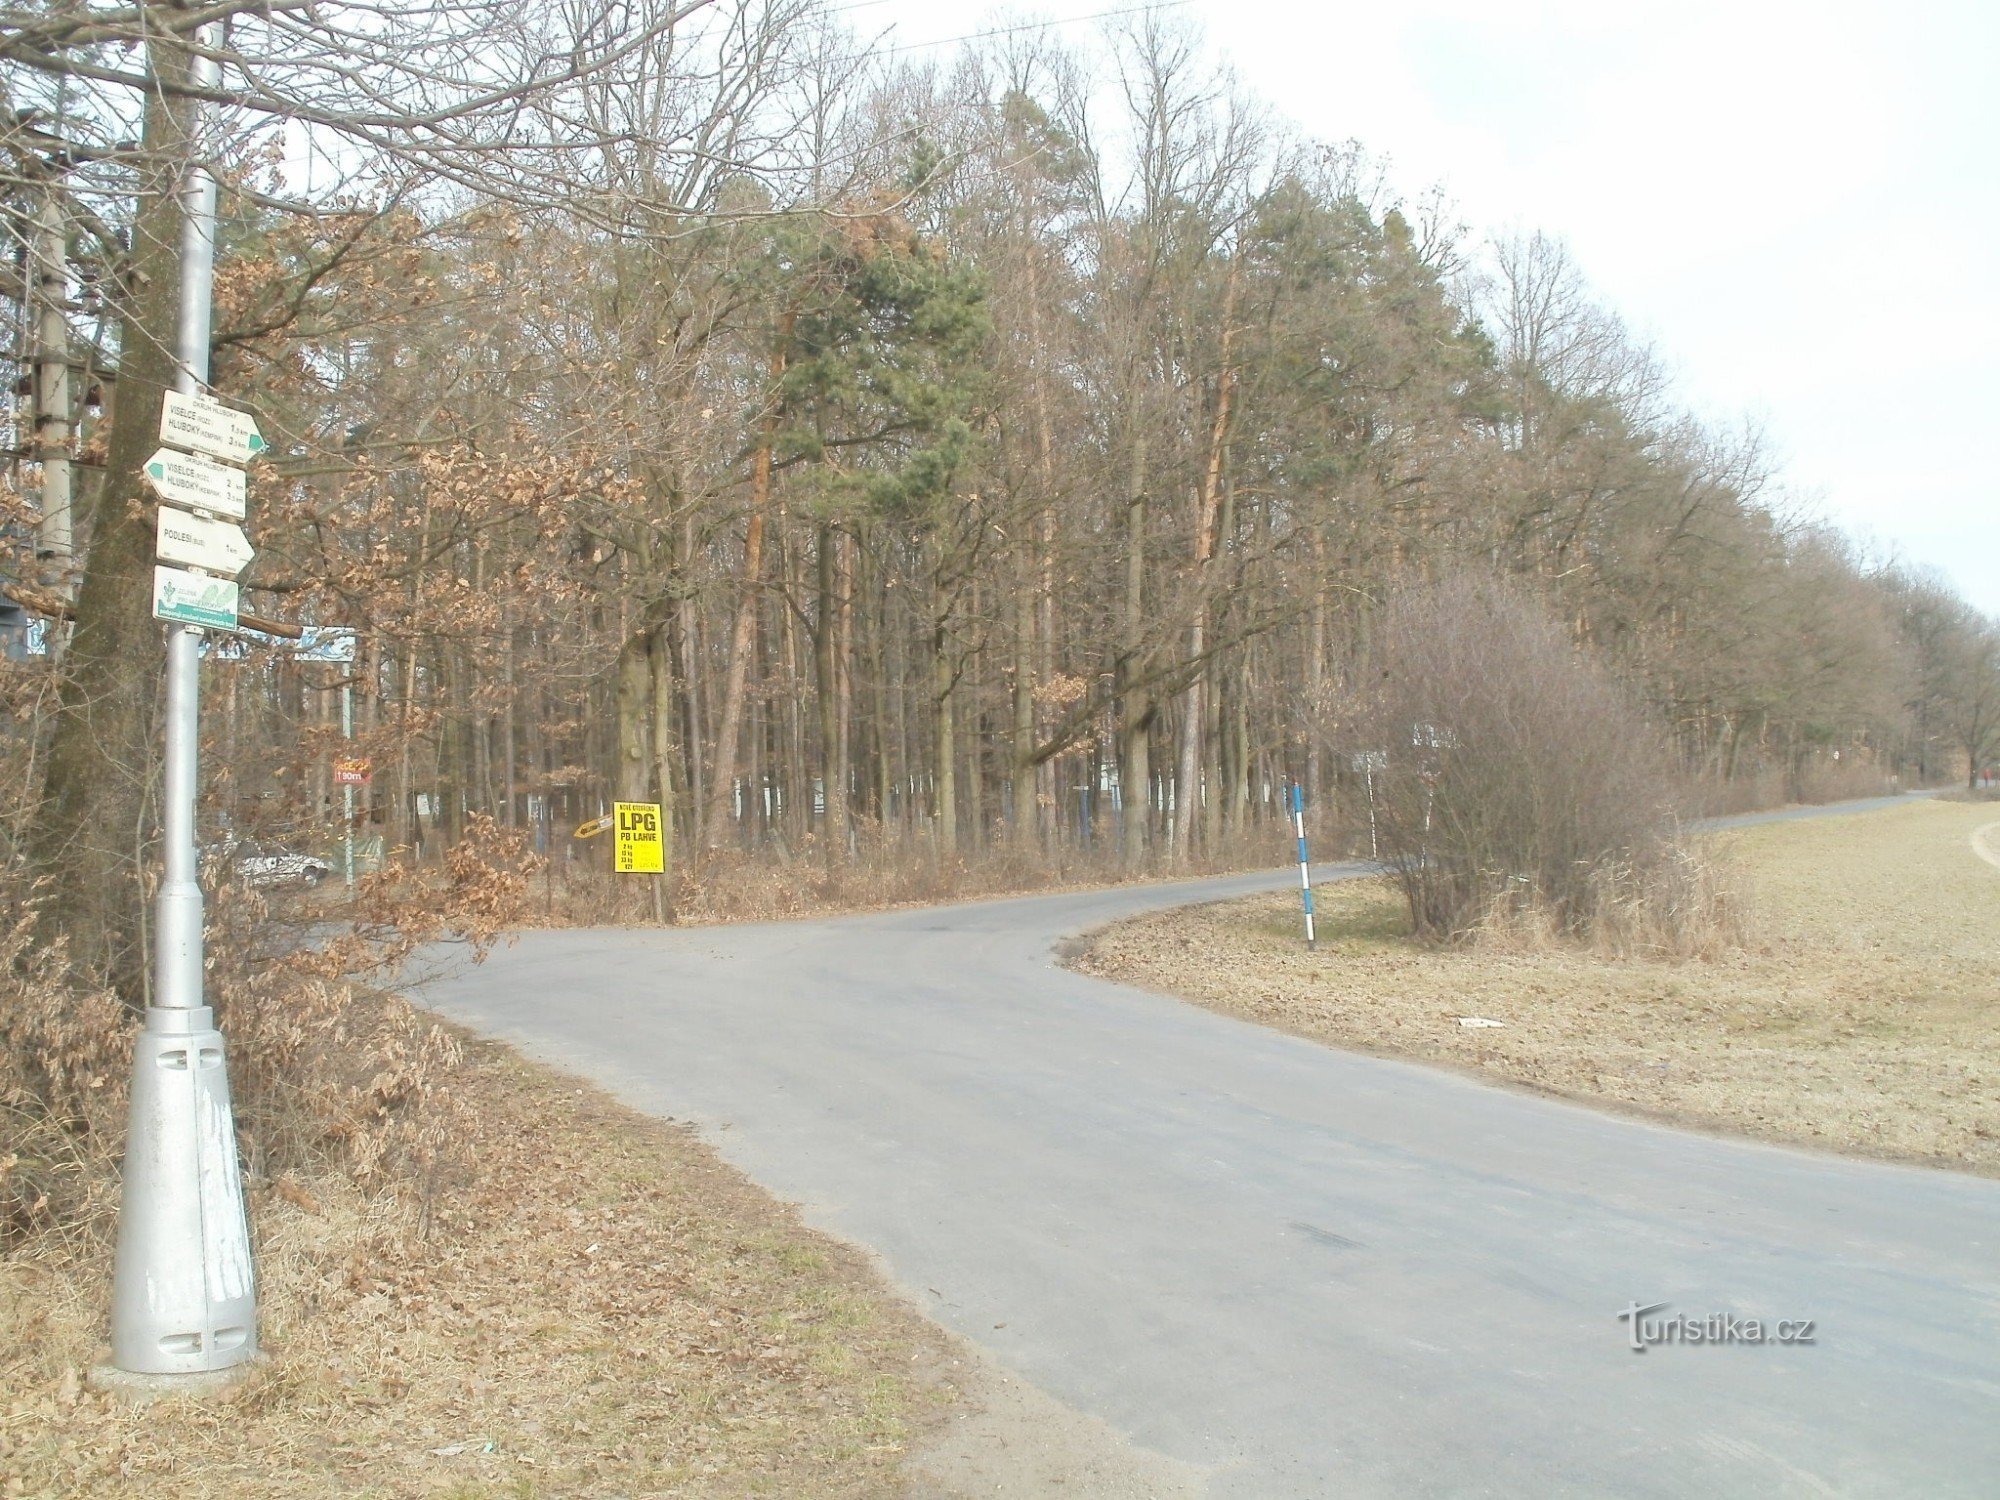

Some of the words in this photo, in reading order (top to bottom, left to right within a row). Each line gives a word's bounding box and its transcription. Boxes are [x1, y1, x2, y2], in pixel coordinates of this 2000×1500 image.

[170, 405, 197, 420] VISELCE
[168, 418, 201, 435] HLUBOKY
[167, 463, 195, 478] VISELCE
[167, 475, 199, 490] HLUBOKY
[620, 812, 656, 831] LPG
[620, 832, 631, 841] PB
[633, 832, 657, 842] LAHVE
